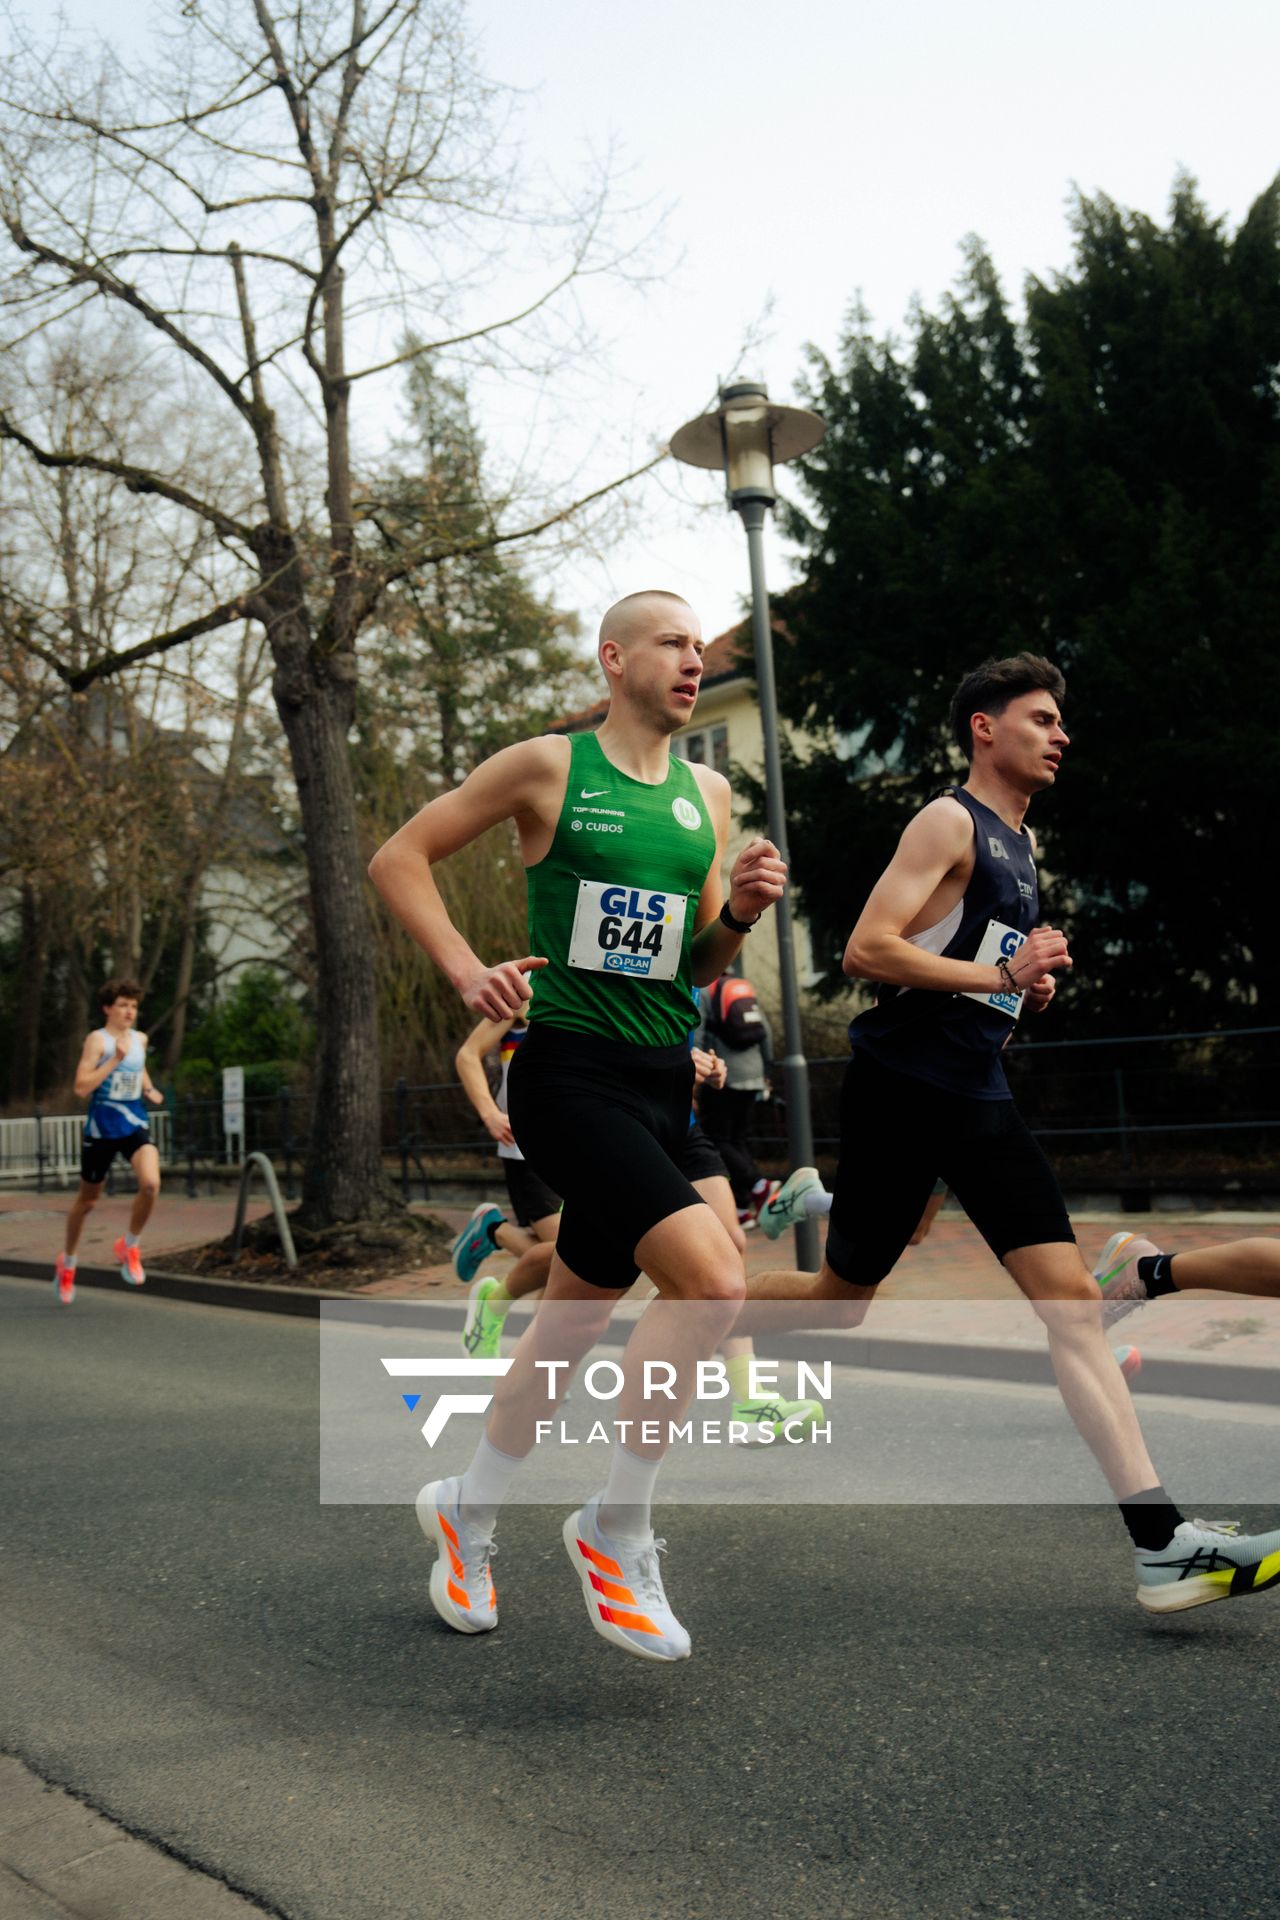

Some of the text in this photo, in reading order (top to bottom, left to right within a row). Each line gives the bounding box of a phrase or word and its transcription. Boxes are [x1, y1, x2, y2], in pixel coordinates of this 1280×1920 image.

[586, 822, 623, 833] CUBOS
[598, 916, 664, 957] 644
[624, 957, 650, 969] PLAN
